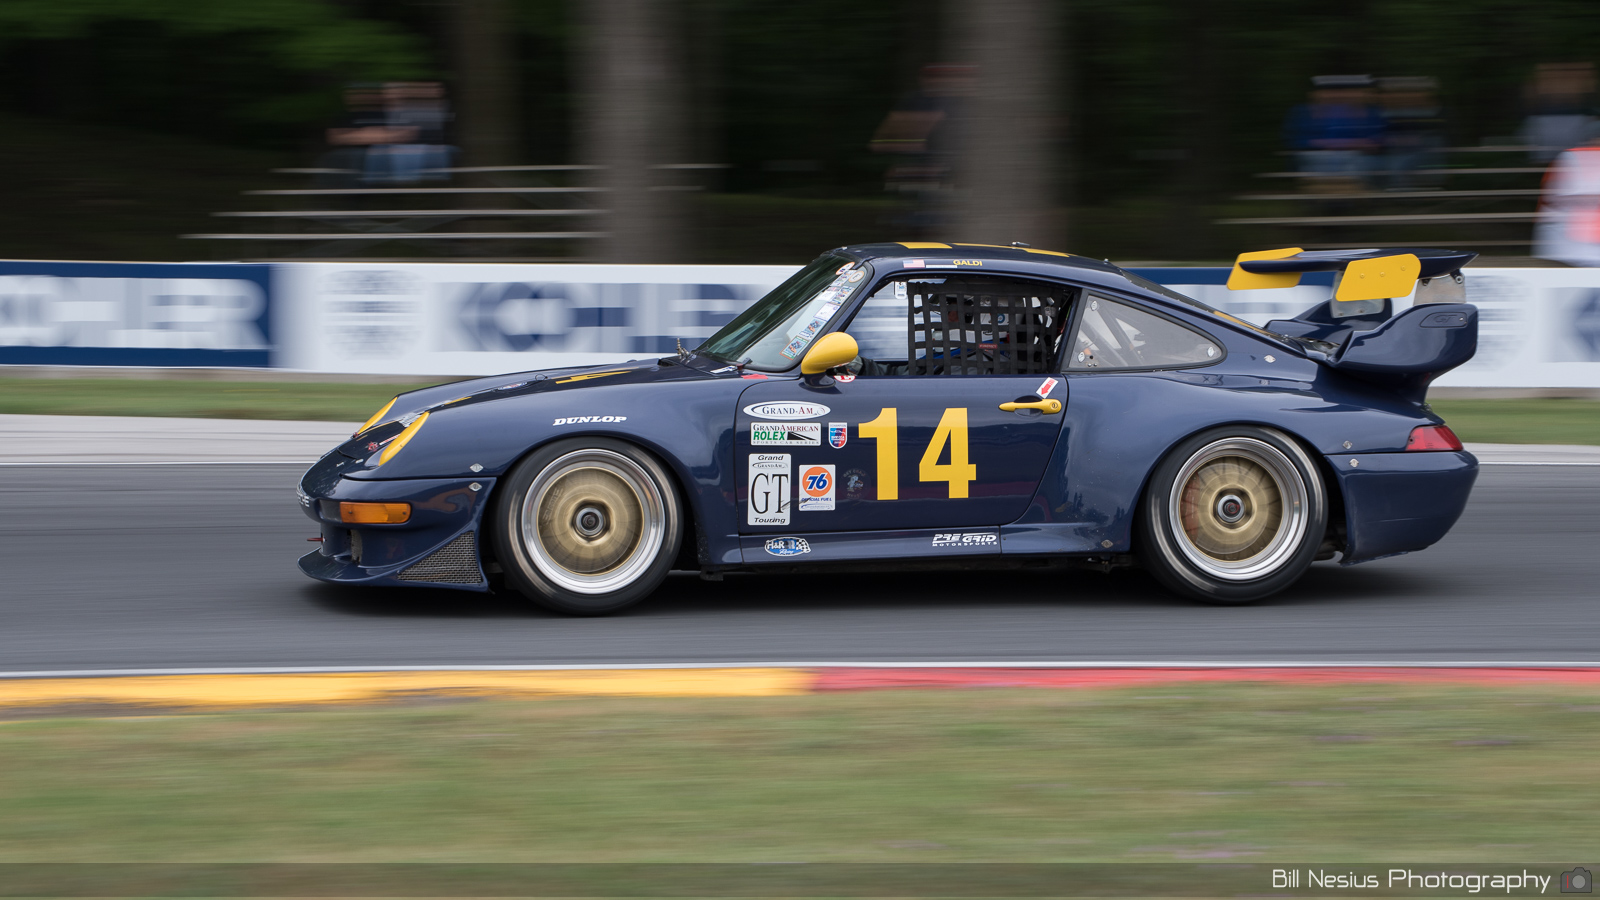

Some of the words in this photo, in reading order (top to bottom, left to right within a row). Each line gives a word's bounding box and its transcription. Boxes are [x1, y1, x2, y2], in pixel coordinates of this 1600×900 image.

[552, 416, 627, 426] DUNLOP
[753, 431, 786, 441] ROLEX
[858, 407, 977, 501] 14
[807, 473, 828, 490] 76
[751, 473, 788, 514] GT
